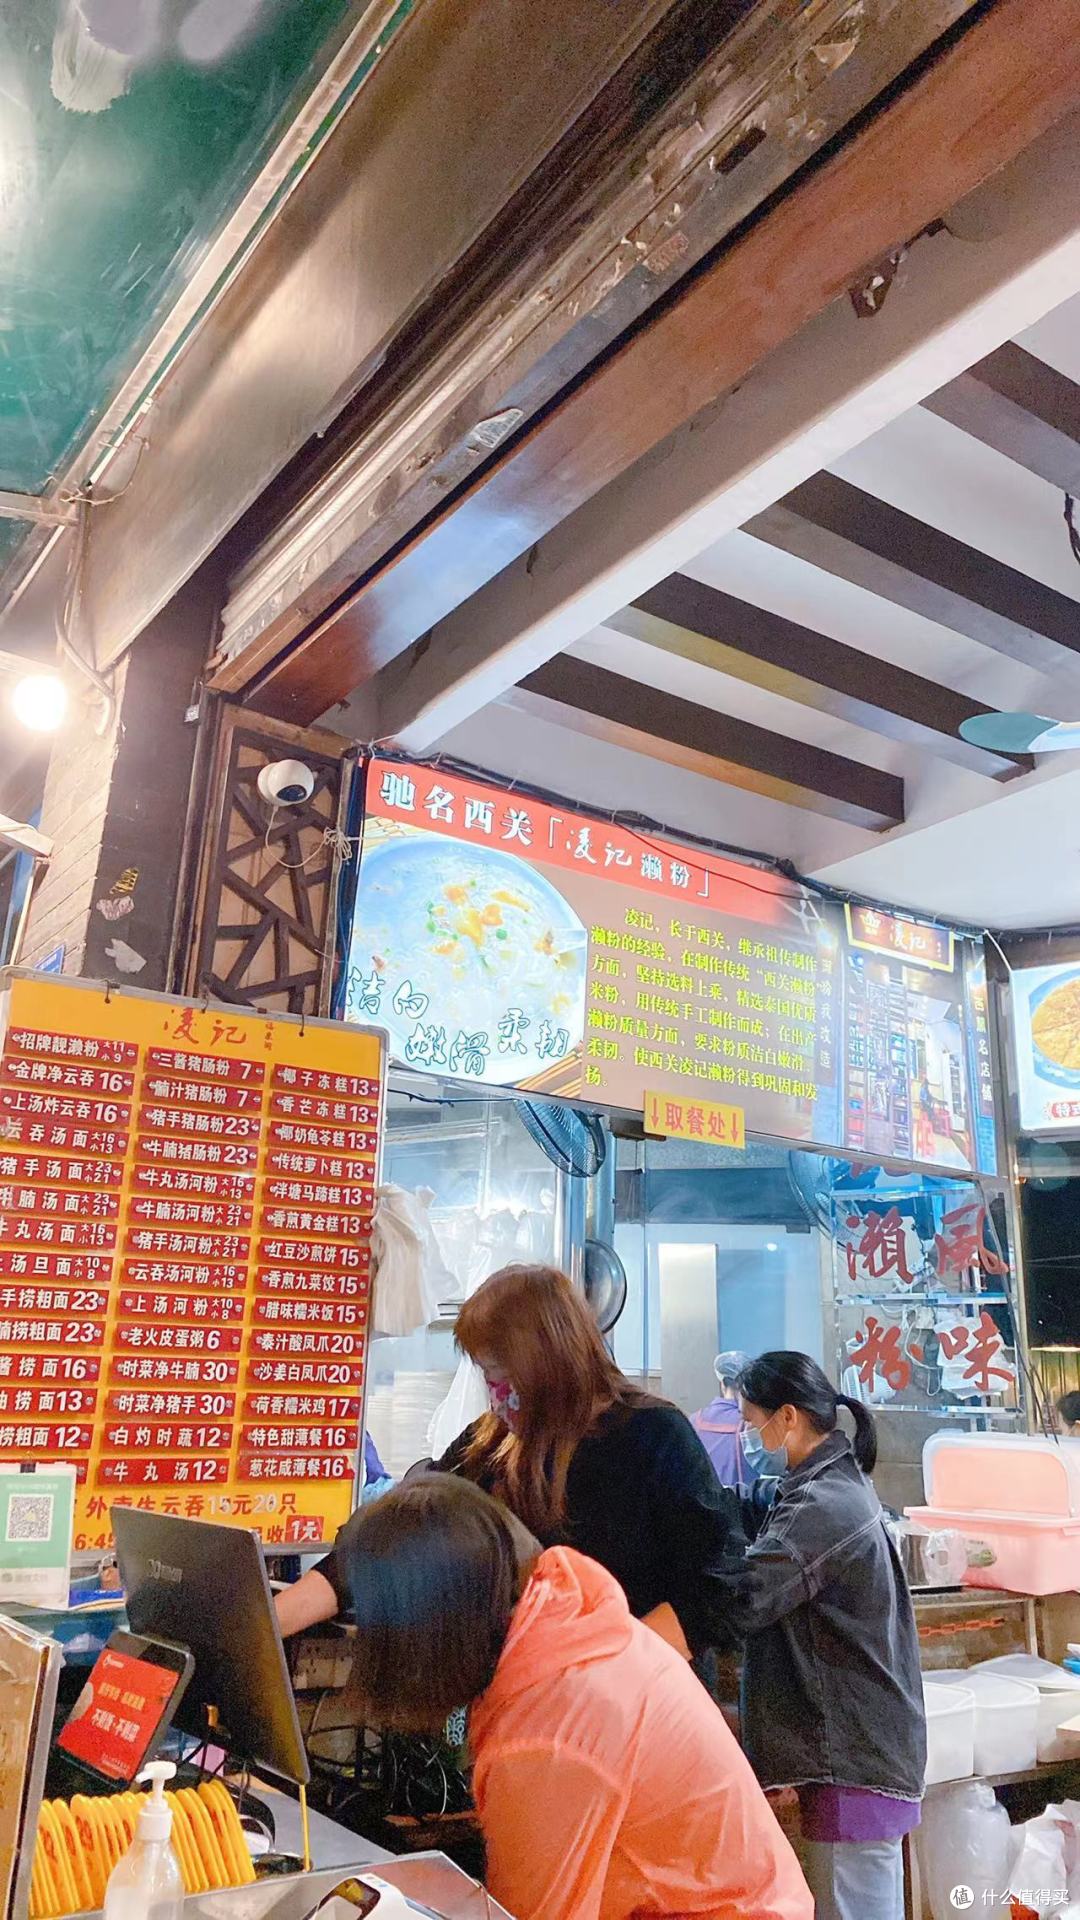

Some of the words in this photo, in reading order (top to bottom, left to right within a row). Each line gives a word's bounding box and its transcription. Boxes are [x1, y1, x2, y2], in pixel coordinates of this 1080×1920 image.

[20, 1032, 99, 1058] 招牌靓濑粉
[15, 1060, 95, 1087] 金牌净云吞
[100, 1073, 123, 1092] 16
[159, 1052, 231, 1076] 三酱猪肠粉
[240, 1063, 252, 1080] 7
[350, 1075, 369, 1095] 13
[11, 1093, 91, 1119] 上汤炸云吞
[94, 1104, 118, 1123] 16
[236, 1090, 249, 1108] 7
[281, 1096, 346, 1120] 香芒冻糕
[350, 1105, 368, 1124] 13
[151, 1109, 224, 1134] 猪手猪肠粉
[225, 1116, 252, 1136] 23
[664, 1102, 727, 1140] 取餐处
[348, 1131, 367, 1151] 13
[223, 1145, 251, 1165] 23
[276, 1153, 343, 1178] 传统萝卜糕
[345, 1162, 365, 1180] 13
[146, 1169, 218, 1193] 牛丸汤河粉
[342, 1188, 362, 1206] 13
[142, 1200, 215, 1224] 牛腩汤河粉
[272, 1209, 339, 1232] 香煎黄金糕
[340, 1216, 360, 1234] 13
[138, 1231, 214, 1255] 猪手汤河粉
[268, 1241, 337, 1262] 红豆沙煎饼
[340, 1248, 359, 1266] 15
[0, 1253, 72, 1276] 汤旦面
[134, 1262, 209, 1283] 云吞汤河粉
[338, 1275, 358, 1294] 15
[71, 1290, 98, 1310] 23
[131, 1295, 208, 1316] 上汤河粉
[265, 1301, 334, 1322] 腊味糯米饭
[336, 1304, 357, 1323] 15
[65, 1322, 94, 1342] 23
[127, 1327, 205, 1348] 老火皮蛋粥
[207, 1330, 220, 1349] 6
[260, 1334, 330, 1353] 泰汁酸凤爪
[330, 1335, 355, 1354] 20
[62, 1358, 87, 1379] 16
[122, 1359, 199, 1382] 时菜净牛腩
[202, 1362, 229, 1382] 30
[258, 1362, 328, 1382] 沙姜白凤爪
[327, 1364, 351, 1384] 20
[56, 1391, 82, 1412] 13
[119, 1394, 197, 1414] 时菜净猪手
[199, 1395, 226, 1415] 30
[256, 1396, 326, 1416] 荷香糯米鸡
[328, 1398, 350, 1417] 17
[55, 1426, 81, 1447] 12
[113, 1426, 193, 1447] 白灼时蔬
[196, 1427, 221, 1447] 12
[326, 1428, 346, 1447] 16
[113, 1460, 189, 1482] 牛丸汤
[192, 1460, 217, 1481] 12
[322, 1458, 344, 1478] 16
